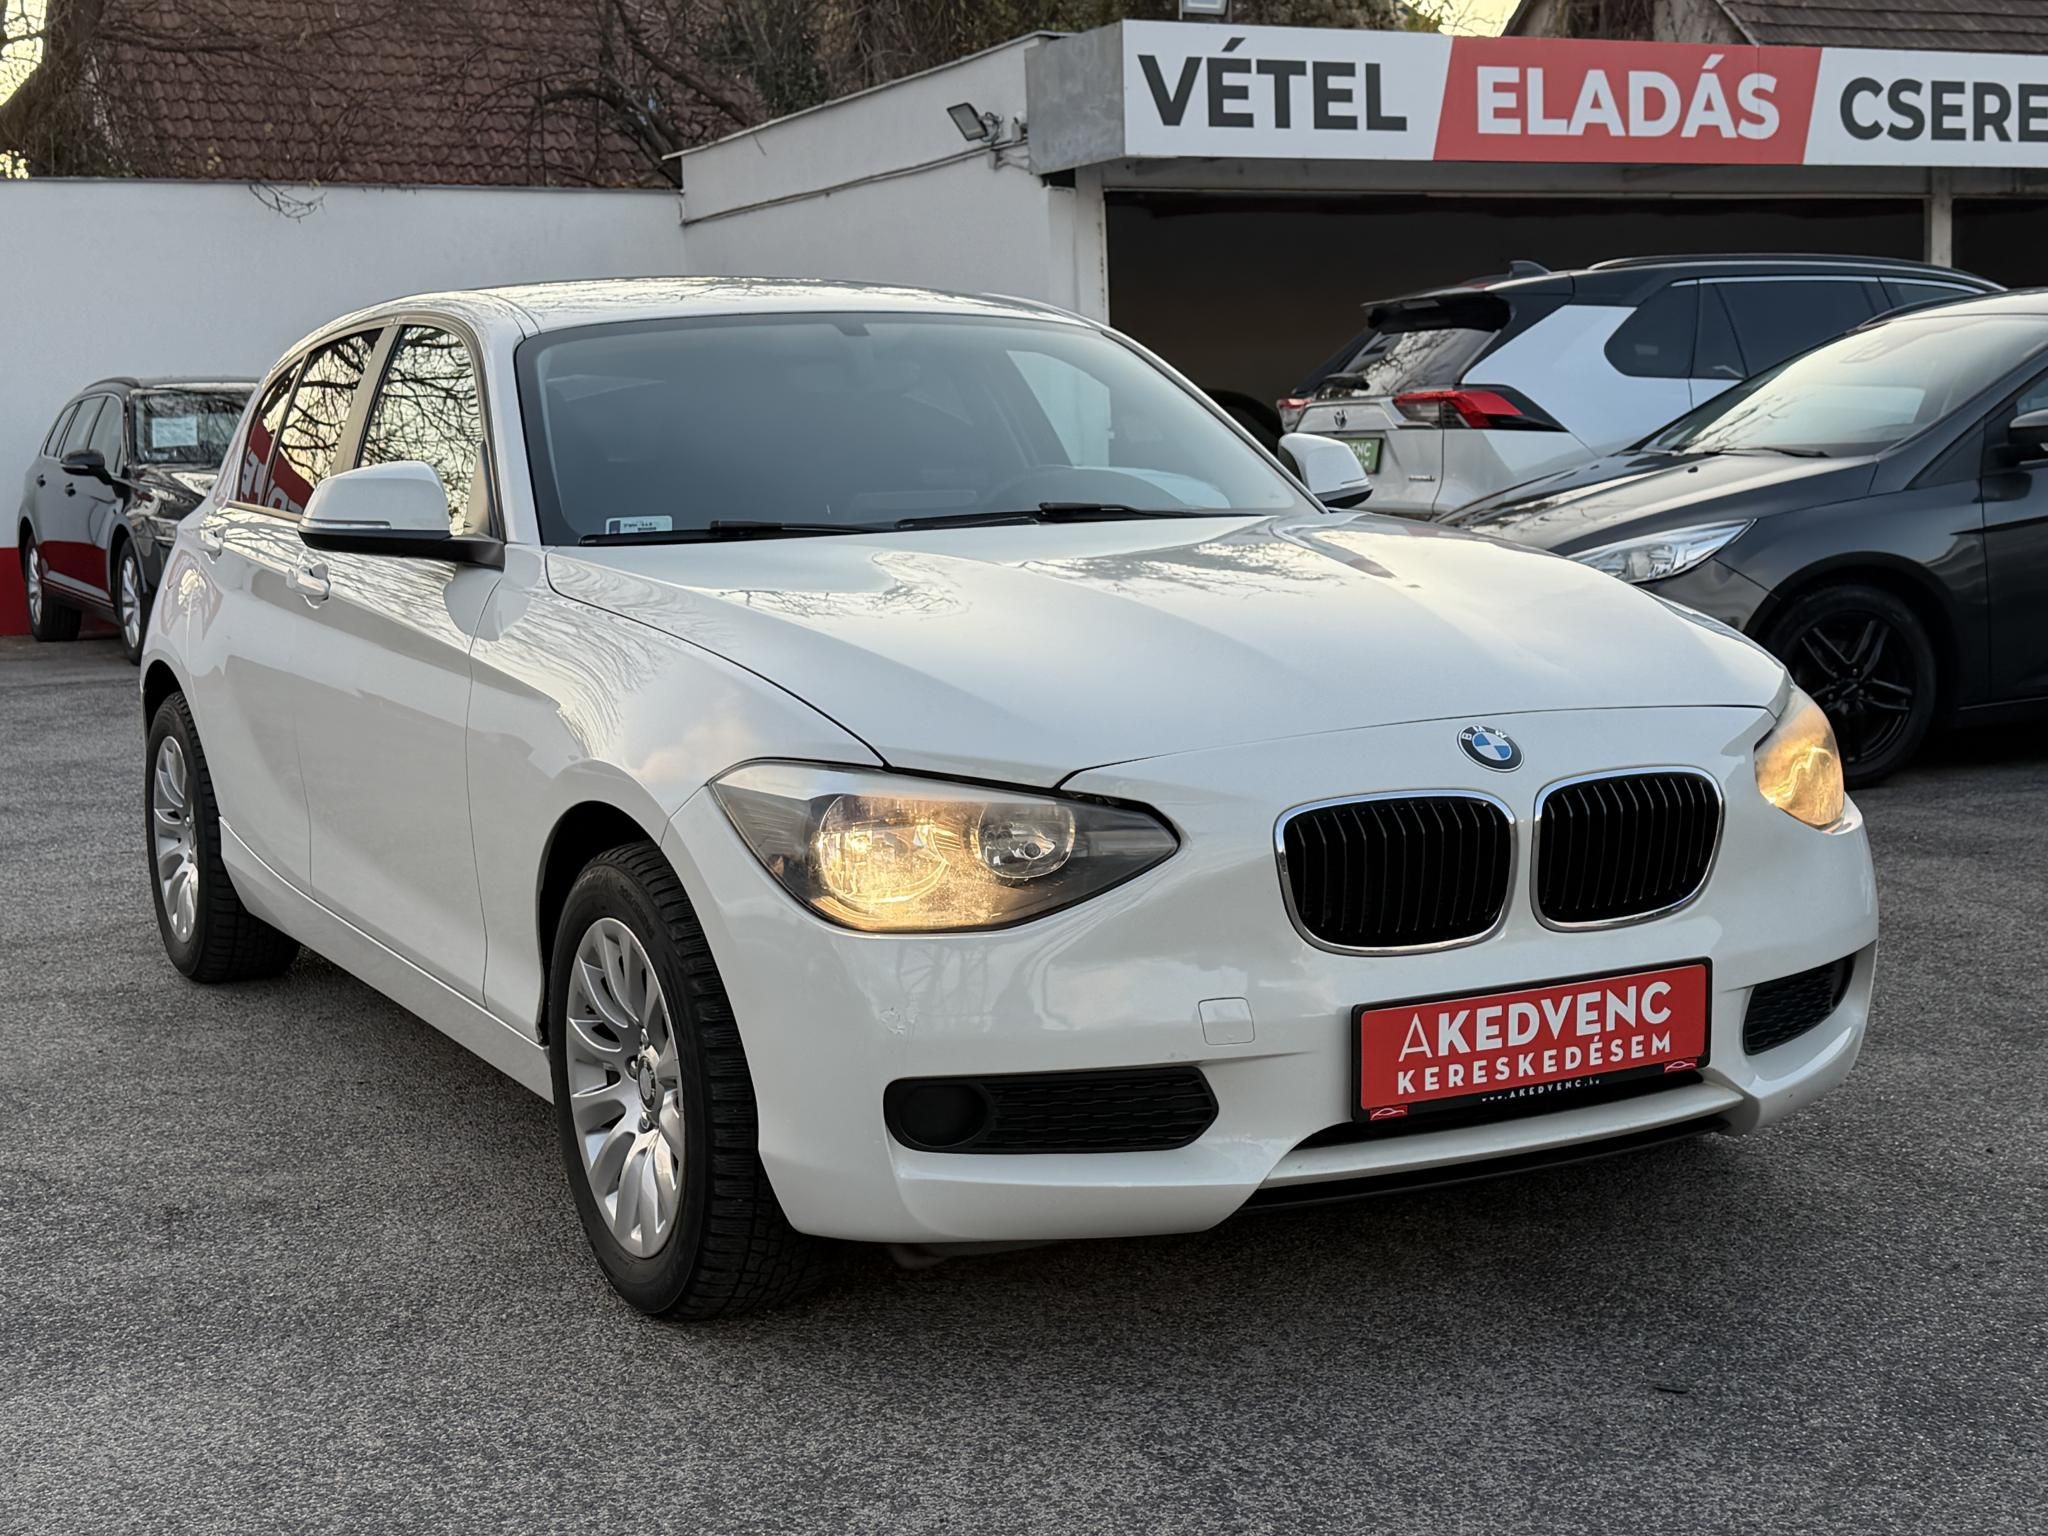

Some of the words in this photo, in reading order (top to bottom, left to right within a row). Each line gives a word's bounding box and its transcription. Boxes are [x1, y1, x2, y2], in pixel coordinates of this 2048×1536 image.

[1137, 37, 1408, 132] VÉTEL
[1477, 54, 1780, 140] ELADÁS
[1840, 76, 2048, 143] CSERE
[1397, 1030, 1671, 1095] KERESKEDÉSEM
